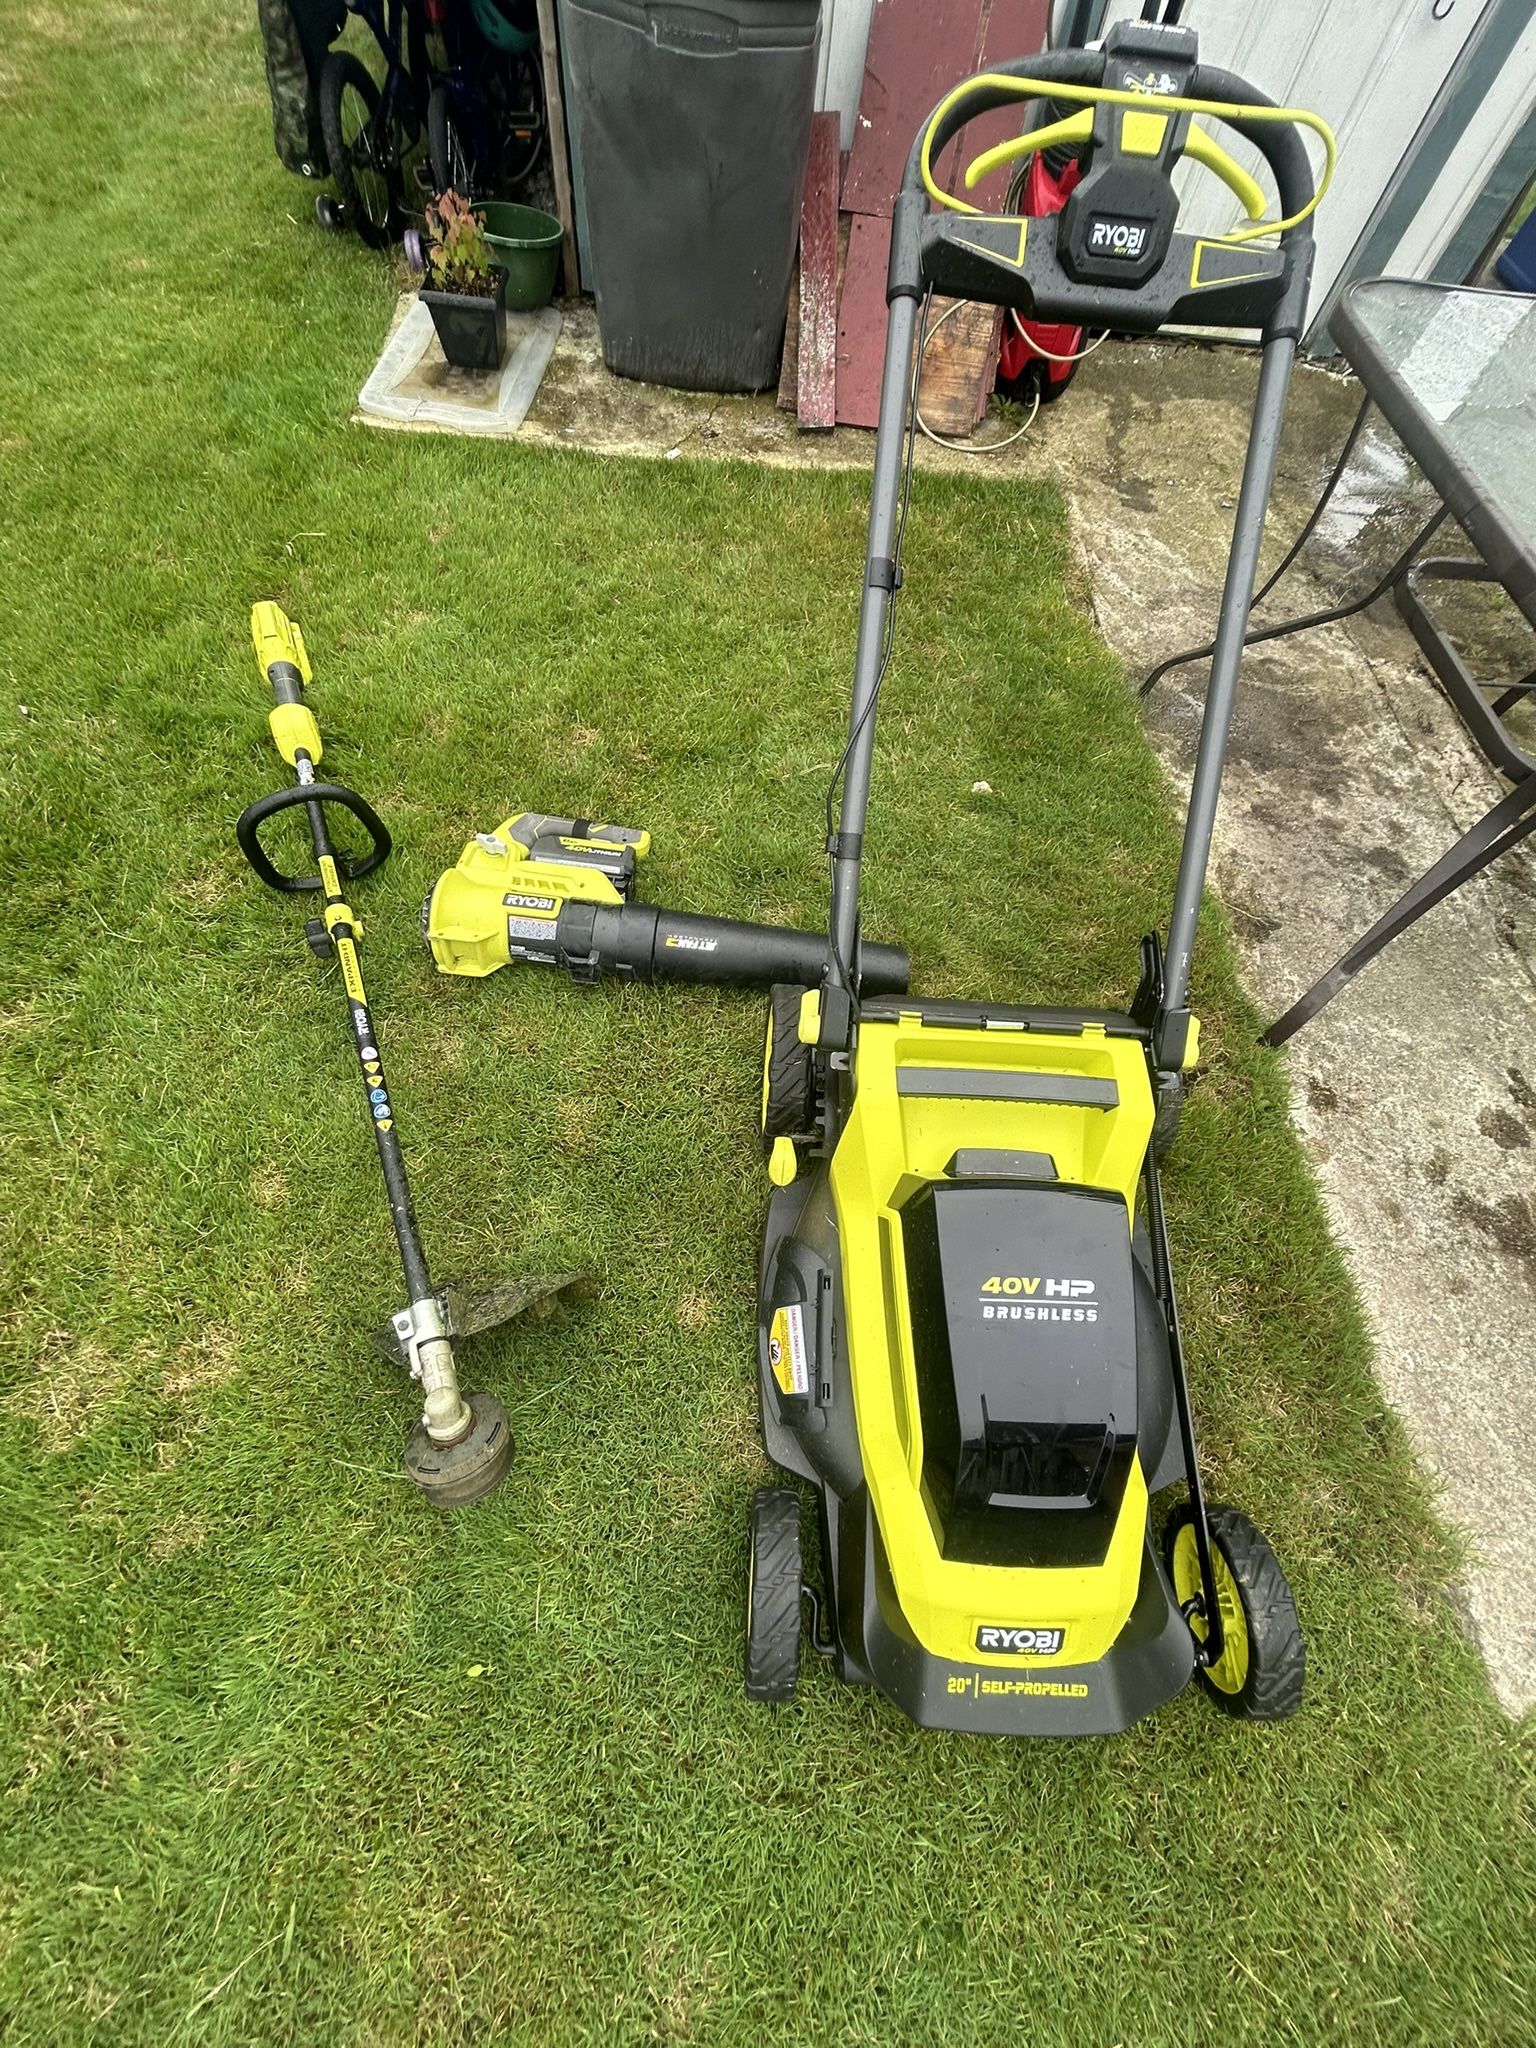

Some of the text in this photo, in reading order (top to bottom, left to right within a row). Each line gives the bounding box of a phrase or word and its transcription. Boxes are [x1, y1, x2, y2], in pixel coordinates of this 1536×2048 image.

[1092, 223, 1146, 248] RYOBI
[506, 895, 554, 909] RYOBI
[353, 1008, 370, 1036] RYOBI
[981, 1276, 1096, 1297] 40V HP
[982, 1305, 1098, 1322] BRUSHLESS
[981, 1628, 1060, 1648] RYOBI
[981, 1680, 1089, 1698] SELF-PROPELLED
